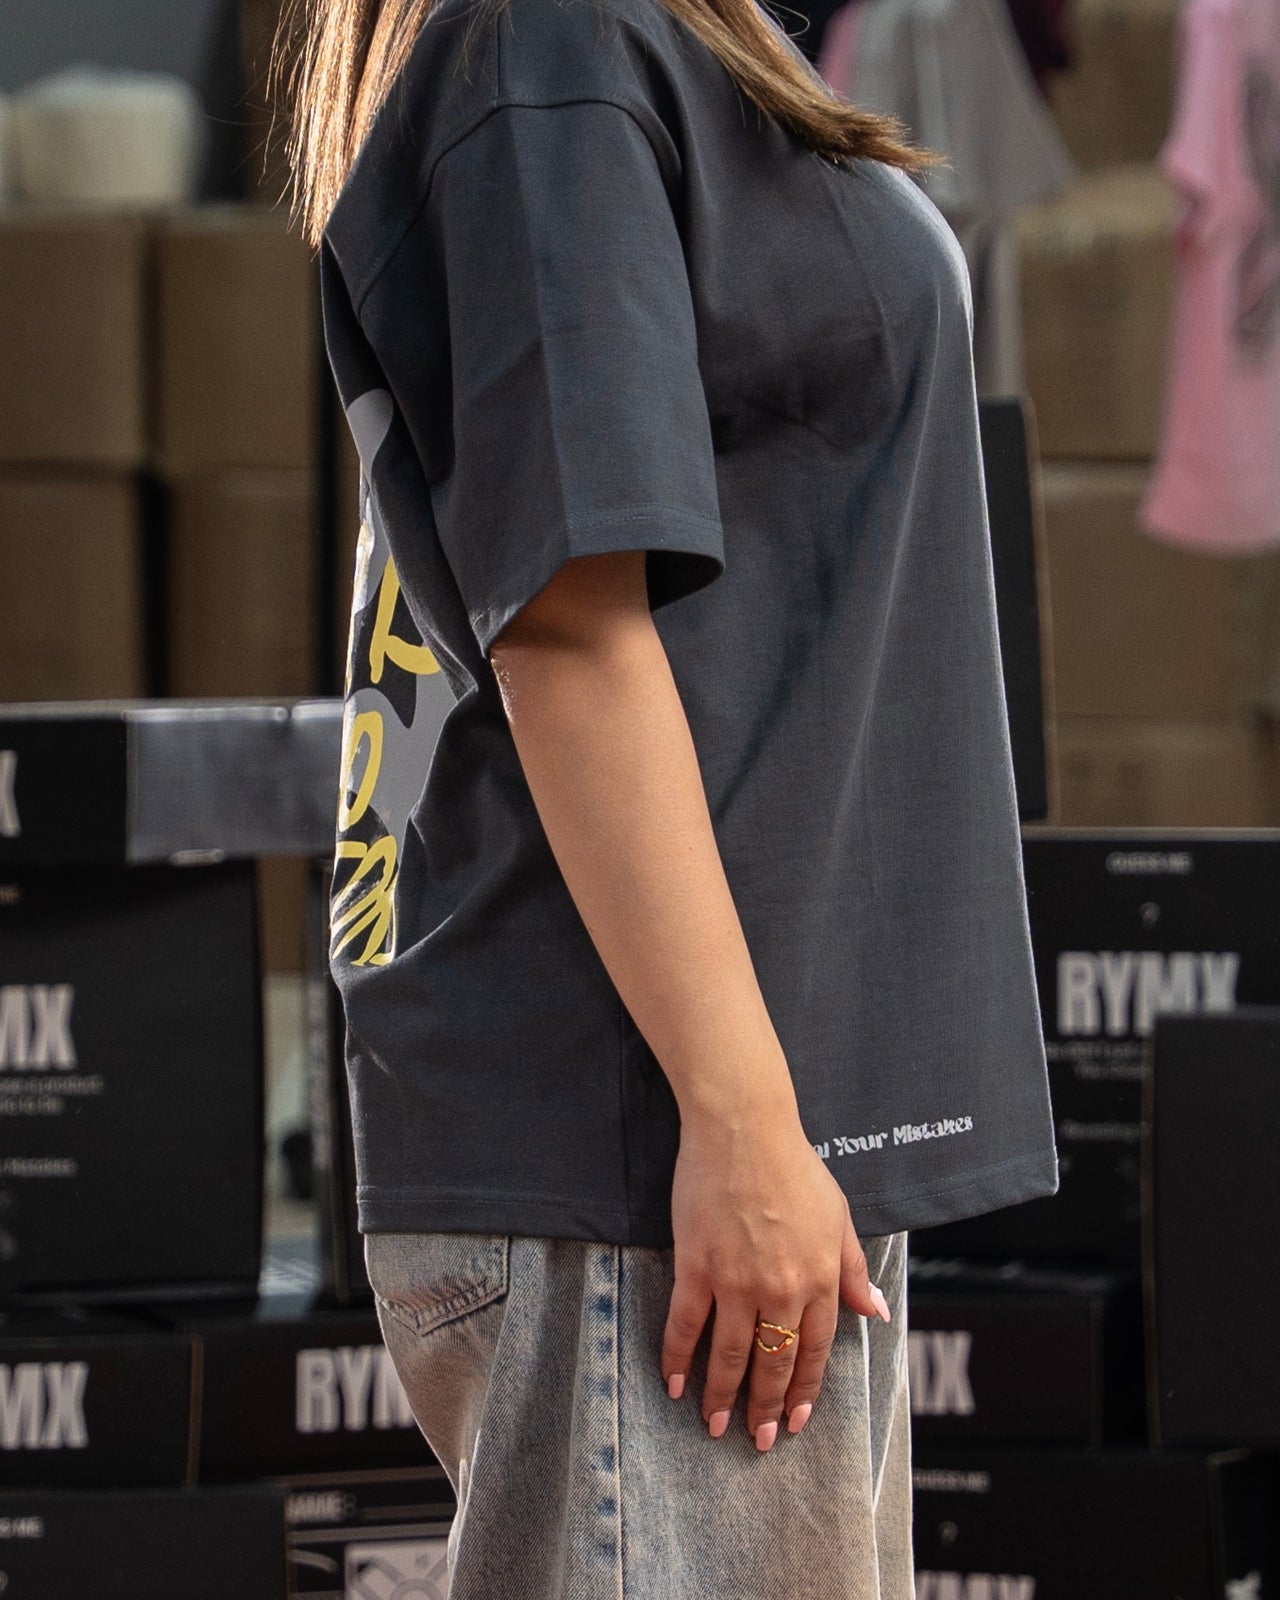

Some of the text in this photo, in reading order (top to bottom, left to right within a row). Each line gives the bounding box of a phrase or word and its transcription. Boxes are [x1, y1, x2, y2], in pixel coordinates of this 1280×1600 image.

[1056, 951, 1239, 1036] RYMX
[834, 1132, 888, 1156] Your
[893, 1115, 973, 1146] Mistakes
[297, 1347, 414, 1432] RYM
[13, 1518, 44, 1537] ME
